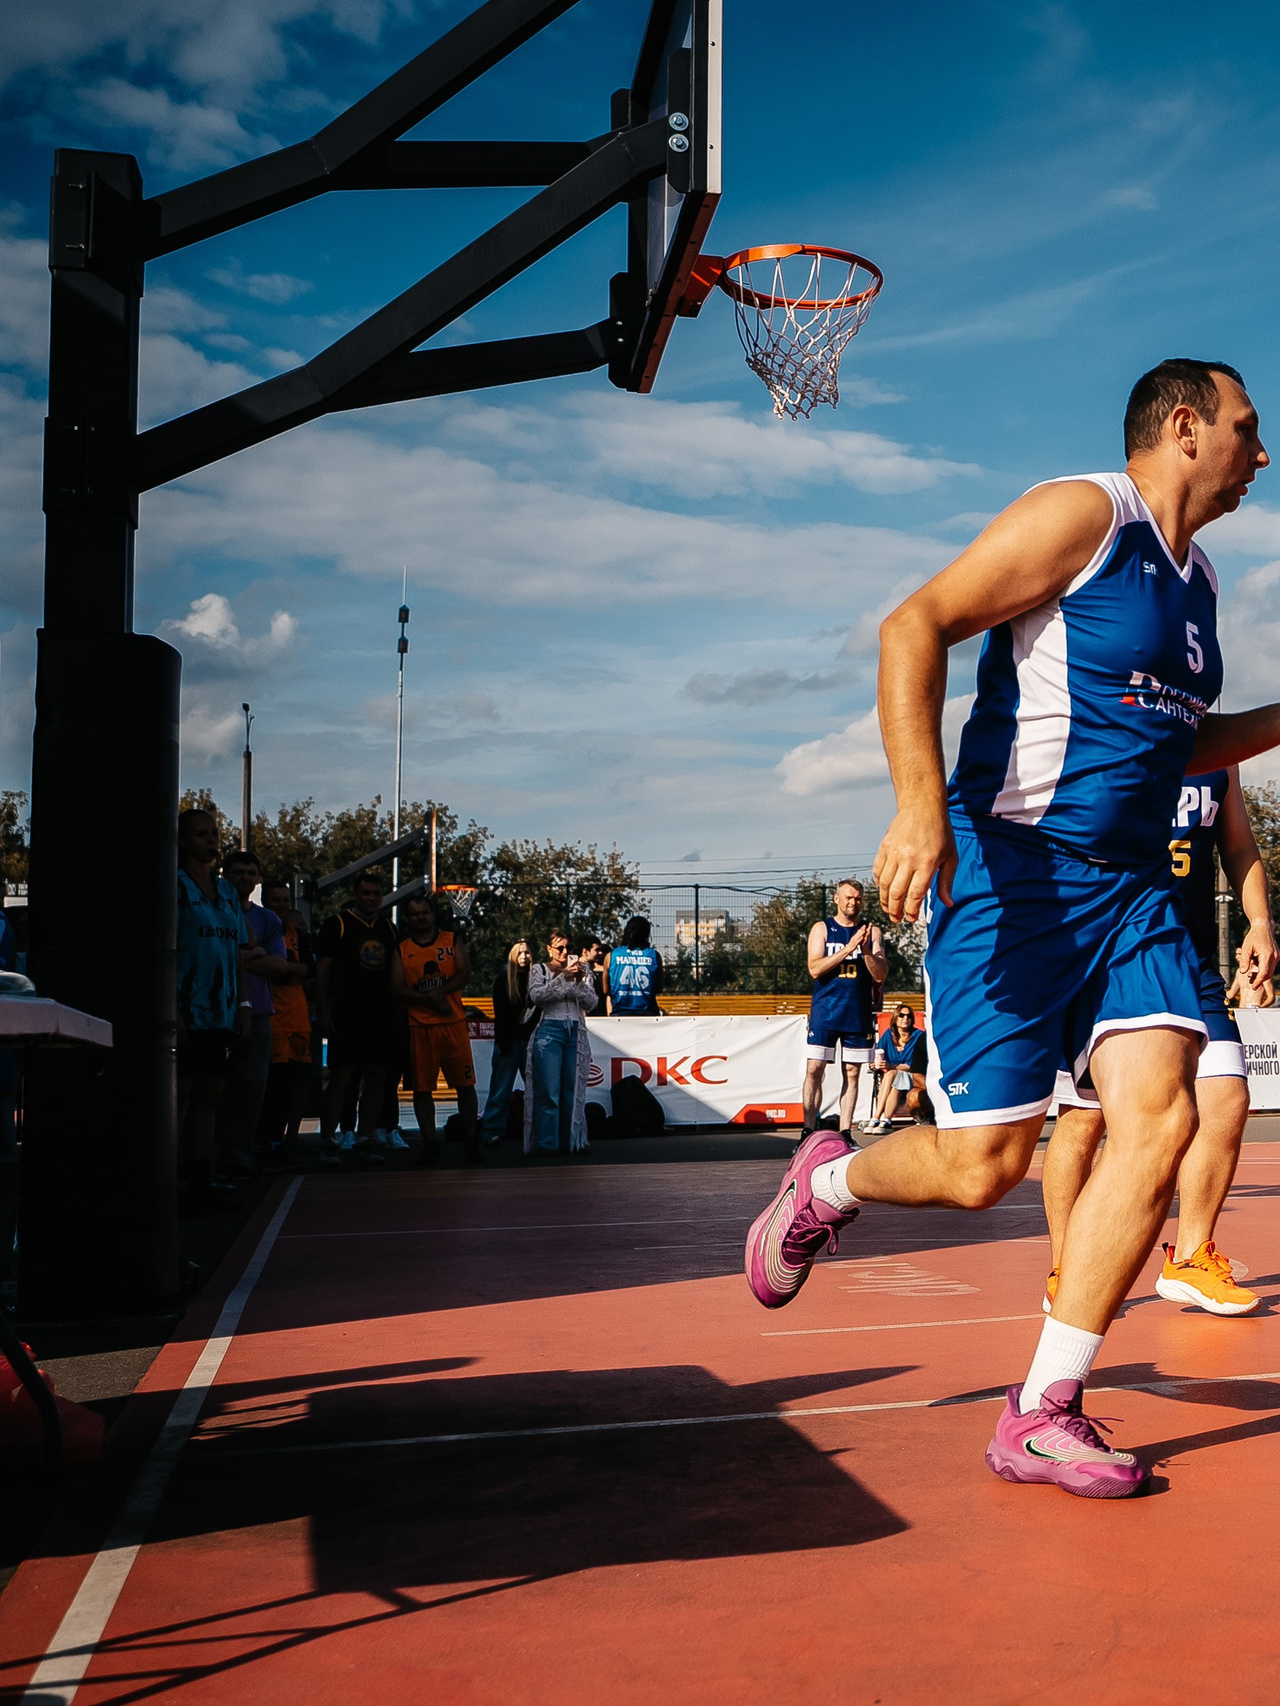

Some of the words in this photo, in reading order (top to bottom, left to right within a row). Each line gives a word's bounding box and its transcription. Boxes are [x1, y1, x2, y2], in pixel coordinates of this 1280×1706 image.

[1186, 621, 1204, 674] 5
[620, 965, 650, 989] 46
[838, 964, 857, 978] 10
[1244, 1041, 1277, 1059] ЕРСКОЙ
[611, 1055, 728, 1087] DKC
[1247, 1060, 1279, 1076] ИЧНОГО
[948, 1082, 969, 1096] STK
